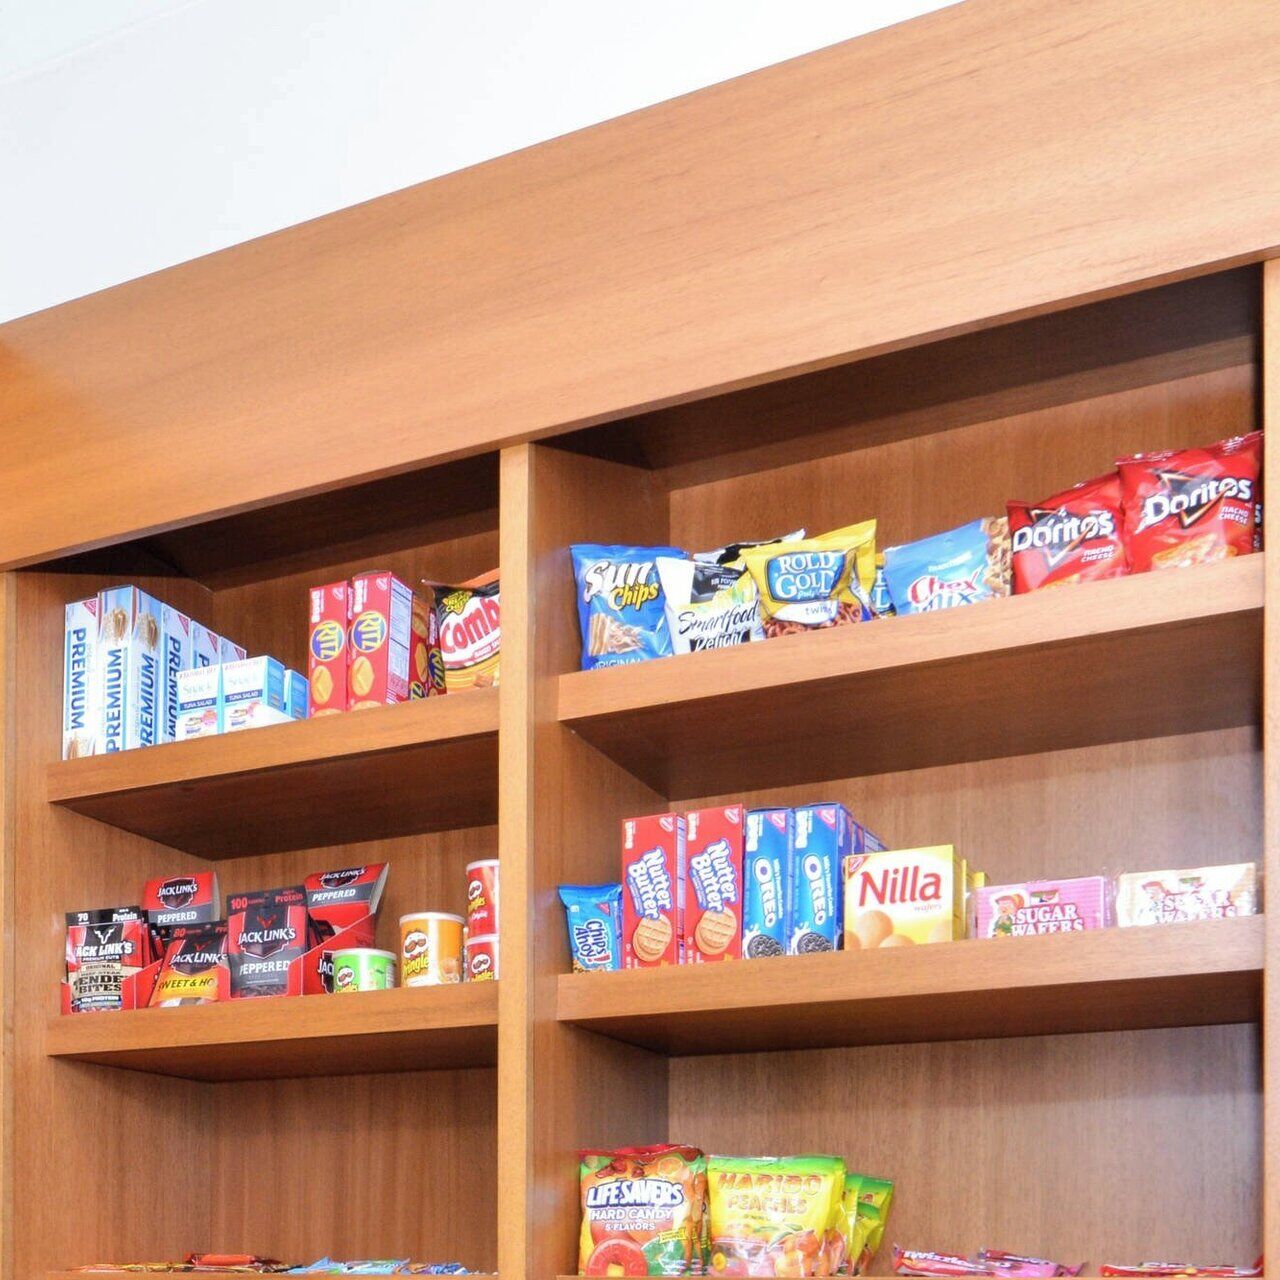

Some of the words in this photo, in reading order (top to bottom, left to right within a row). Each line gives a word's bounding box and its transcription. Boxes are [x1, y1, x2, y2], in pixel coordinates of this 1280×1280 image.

[1134, 478, 1254, 534] Doritos
[1220, 505, 1250, 517] NACHO
[1219, 513, 1249, 526] CHEESE
[1013, 511, 1117, 551] Doritos
[1081, 552, 1117, 562] CHEESE
[1083, 545, 1116, 557] NACHO
[777, 552, 838, 575] ROLD
[774, 568, 841, 598] GOLD
[608, 581, 660, 611] Chips
[677, 601, 759, 636] Smartfood
[316, 623, 338, 660] RITZ
[357, 613, 380, 651] RITZ
[71, 628, 87, 730] PREMIUM
[169, 635, 181, 738] PREMIUM
[105, 648, 122, 753] PREMIUM
[320, 873, 339, 881] JACK
[858, 866, 943, 907] Nilla
[158, 888, 176, 898] JACK
[176, 883, 198, 893] LINK'S
[312, 888, 356, 902] PEPPERED
[755, 857, 776, 928] OREO
[803, 855, 825, 926] OREO
[231, 897, 248, 910] 100
[1016, 903, 1078, 924] SUGAR
[77, 912, 89, 922] 70
[112, 912, 138, 923] Protein
[157, 911, 197, 923] PEPPERED
[238, 931, 262, 945] JACK
[263, 926, 296, 942] LINK'S
[585, 919, 608, 957] Chips
[1012, 919, 1084, 937] WAFERS
[98, 940, 133, 955] LINK'S
[78, 984, 122, 994] BITES
[718, 1172, 823, 1196] HARIBO
[590, 1208, 625, 1221] HARD
[629, 1208, 673, 1221] CANDY
